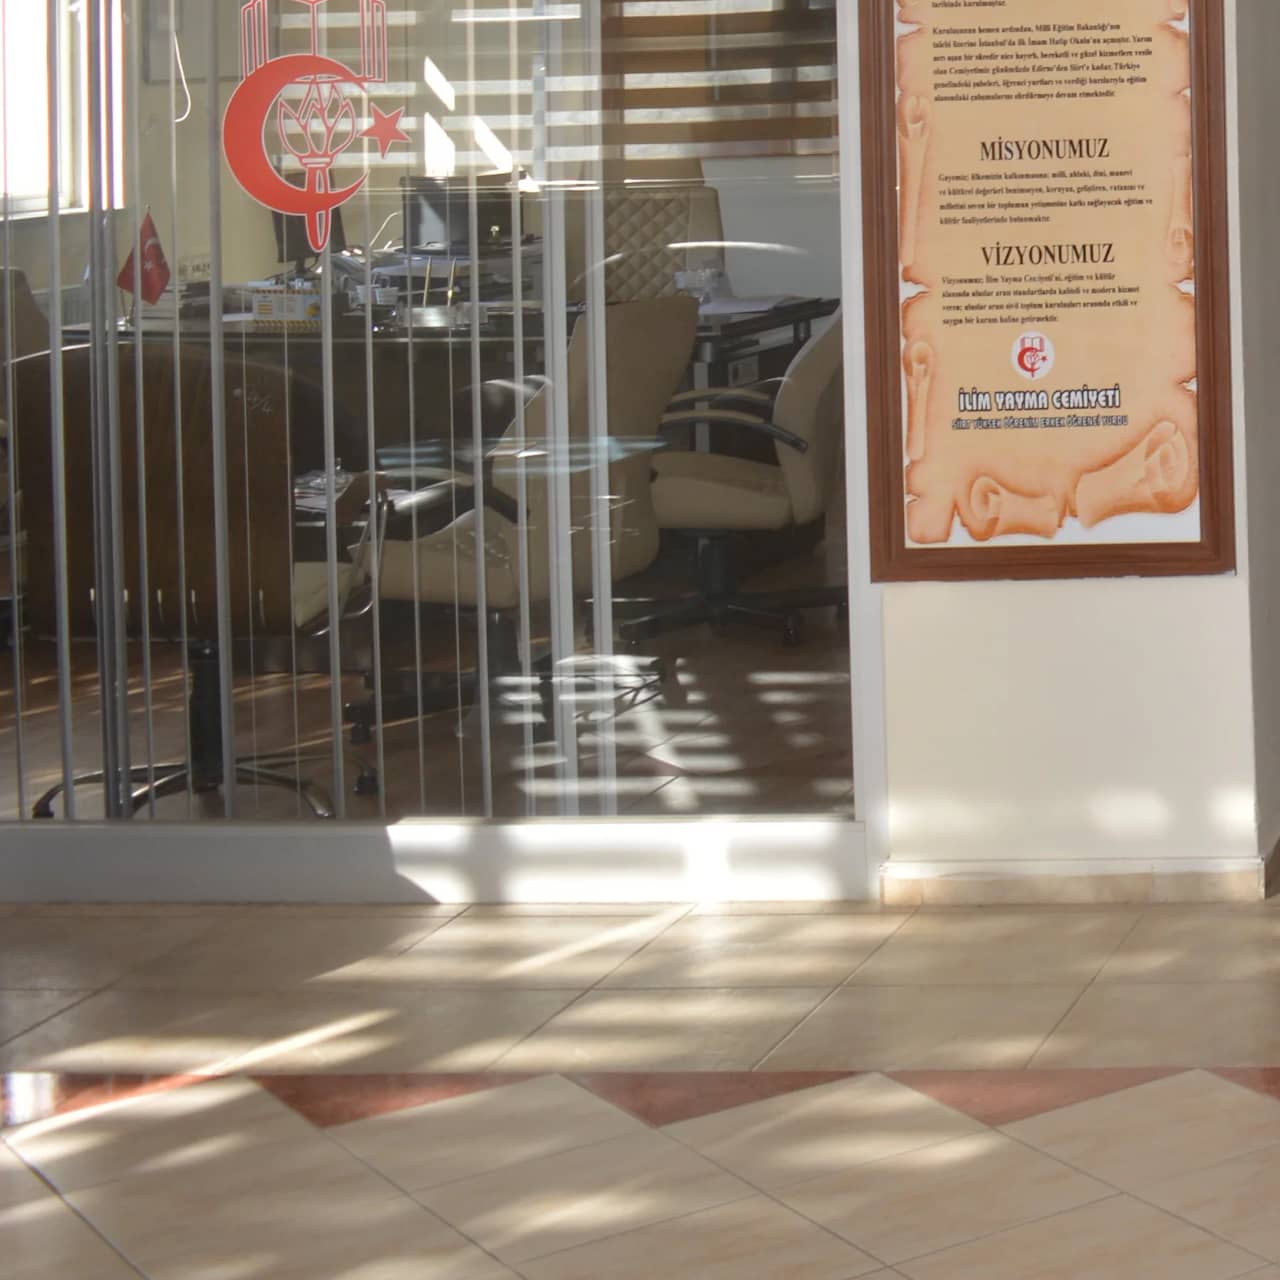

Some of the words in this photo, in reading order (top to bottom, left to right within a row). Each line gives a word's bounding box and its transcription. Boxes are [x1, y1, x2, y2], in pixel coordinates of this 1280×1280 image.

[980, 136, 1110, 161] MİSYONUMUZ
[981, 241, 1115, 266] VİZYONUMUZ
[958, 387, 991, 412] İLİM
[995, 390, 1048, 411] YAYMA
[1052, 384, 1120, 409] CEMİYETİ
